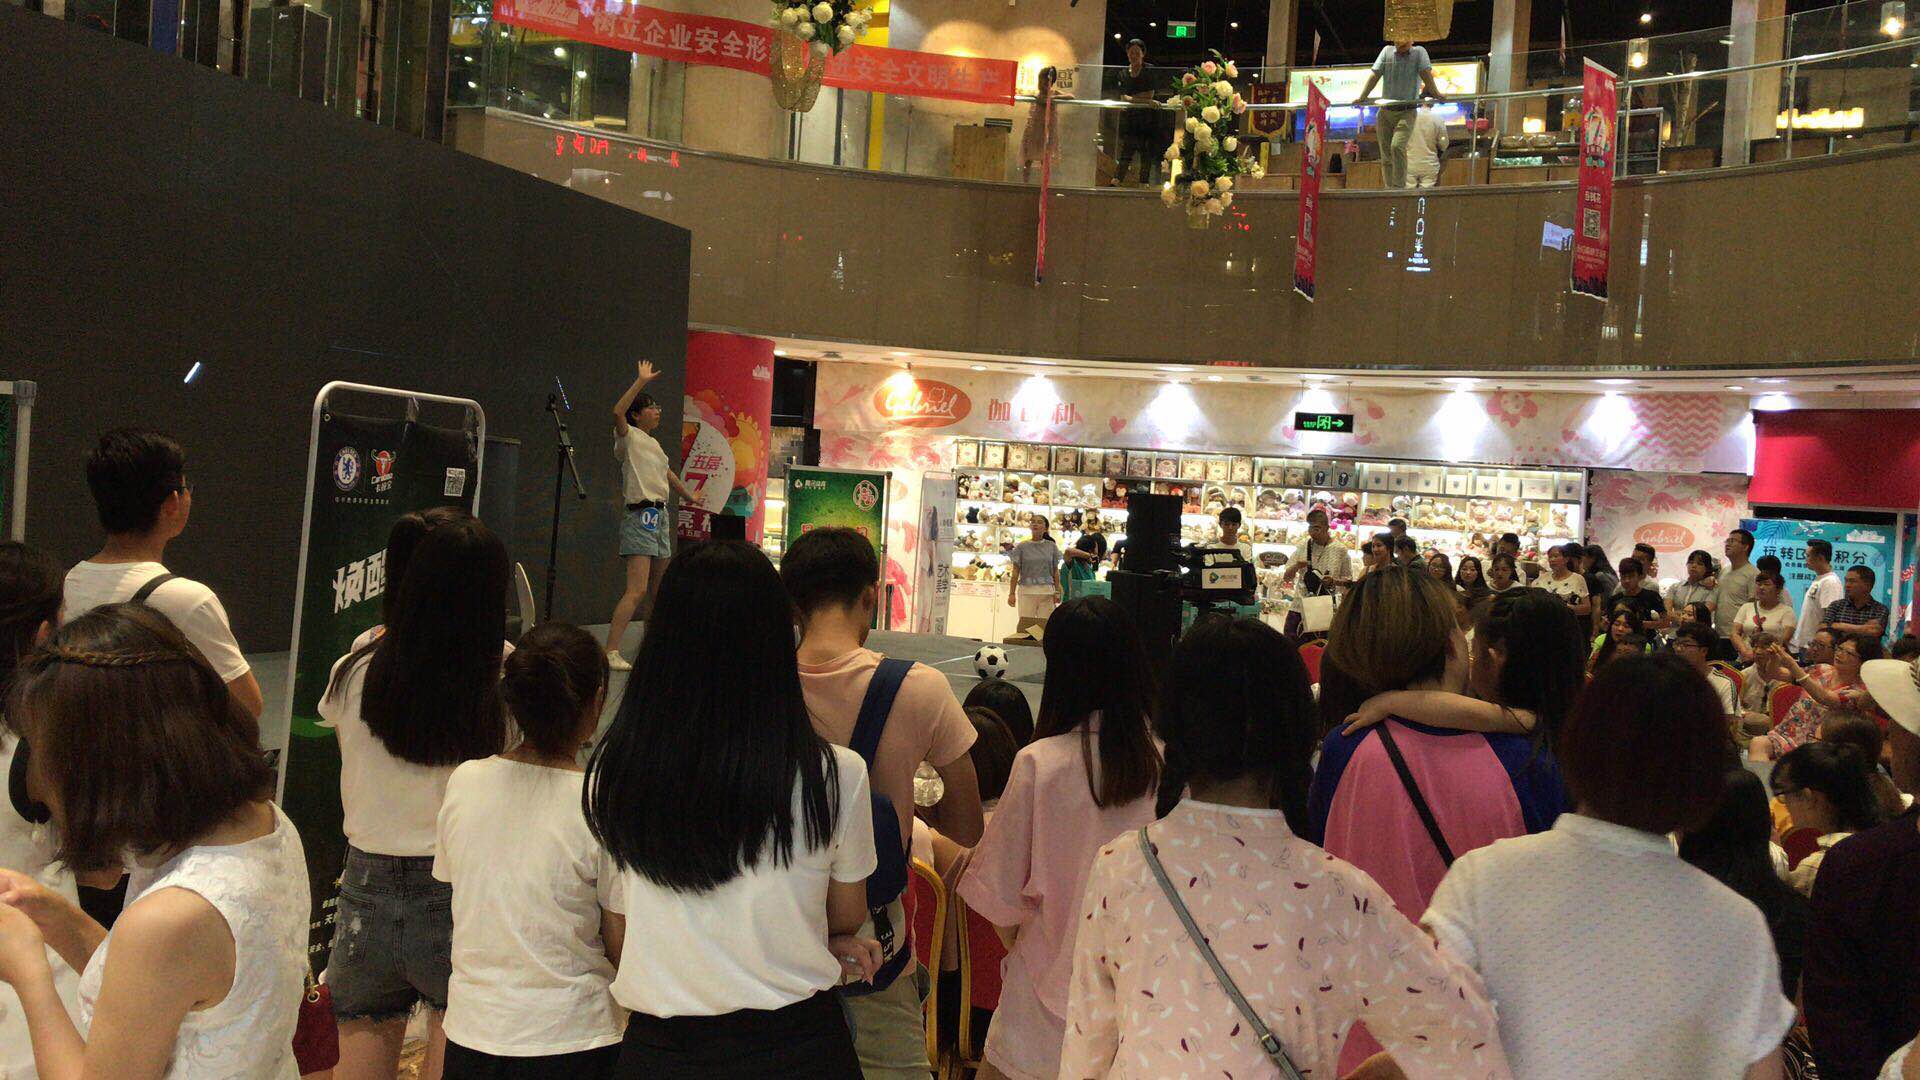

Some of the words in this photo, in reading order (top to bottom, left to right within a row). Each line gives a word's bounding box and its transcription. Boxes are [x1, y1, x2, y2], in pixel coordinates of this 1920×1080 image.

[592, 10, 767, 63] 树立企业安全形
[642, 512, 659, 526] 04
[1834, 550, 1867, 565] 积分
